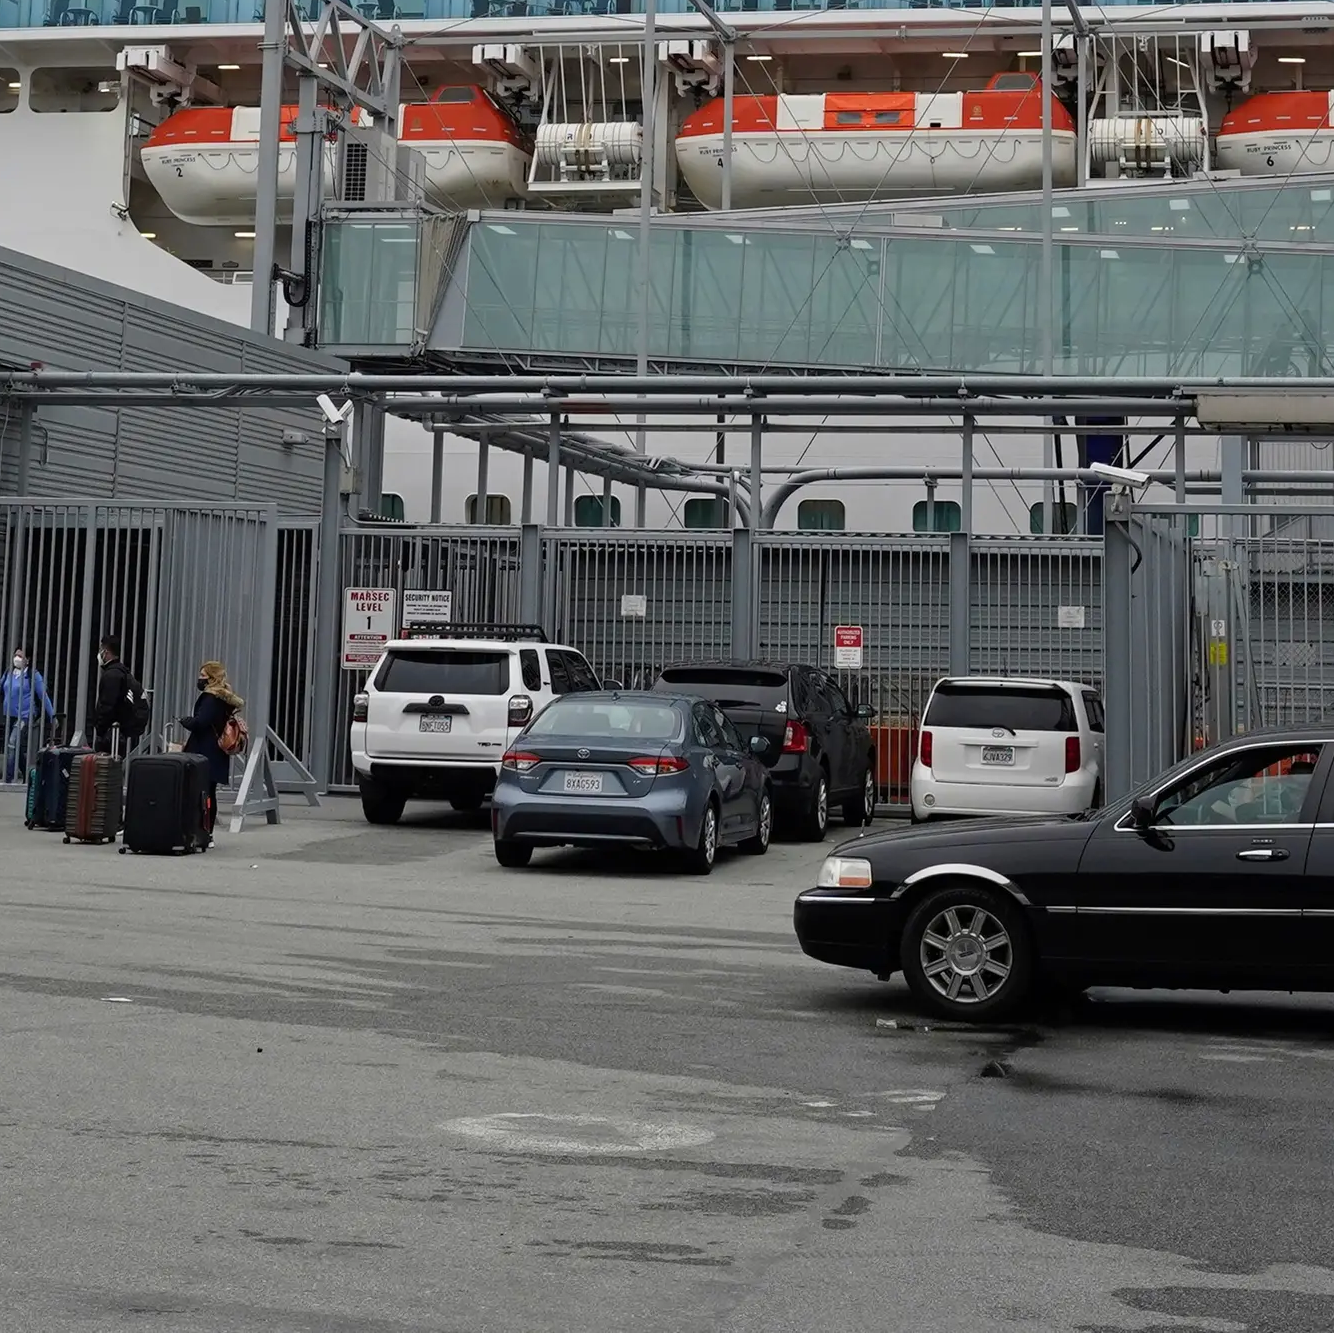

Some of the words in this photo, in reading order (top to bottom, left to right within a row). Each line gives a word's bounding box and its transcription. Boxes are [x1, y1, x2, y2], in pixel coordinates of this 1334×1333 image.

[718, 158, 724, 168] 4
[1267, 156, 1274, 167] 6
[176, 167, 183, 177] 2
[350, 592, 389, 601] MARSEC
[405, 594, 430, 602] SECURITY
[432, 595, 450, 603] NOTICE
[356, 603, 383, 612] LEVEL
[367, 616, 372, 629] 1
[566, 778, 600, 790] 8XAG593
